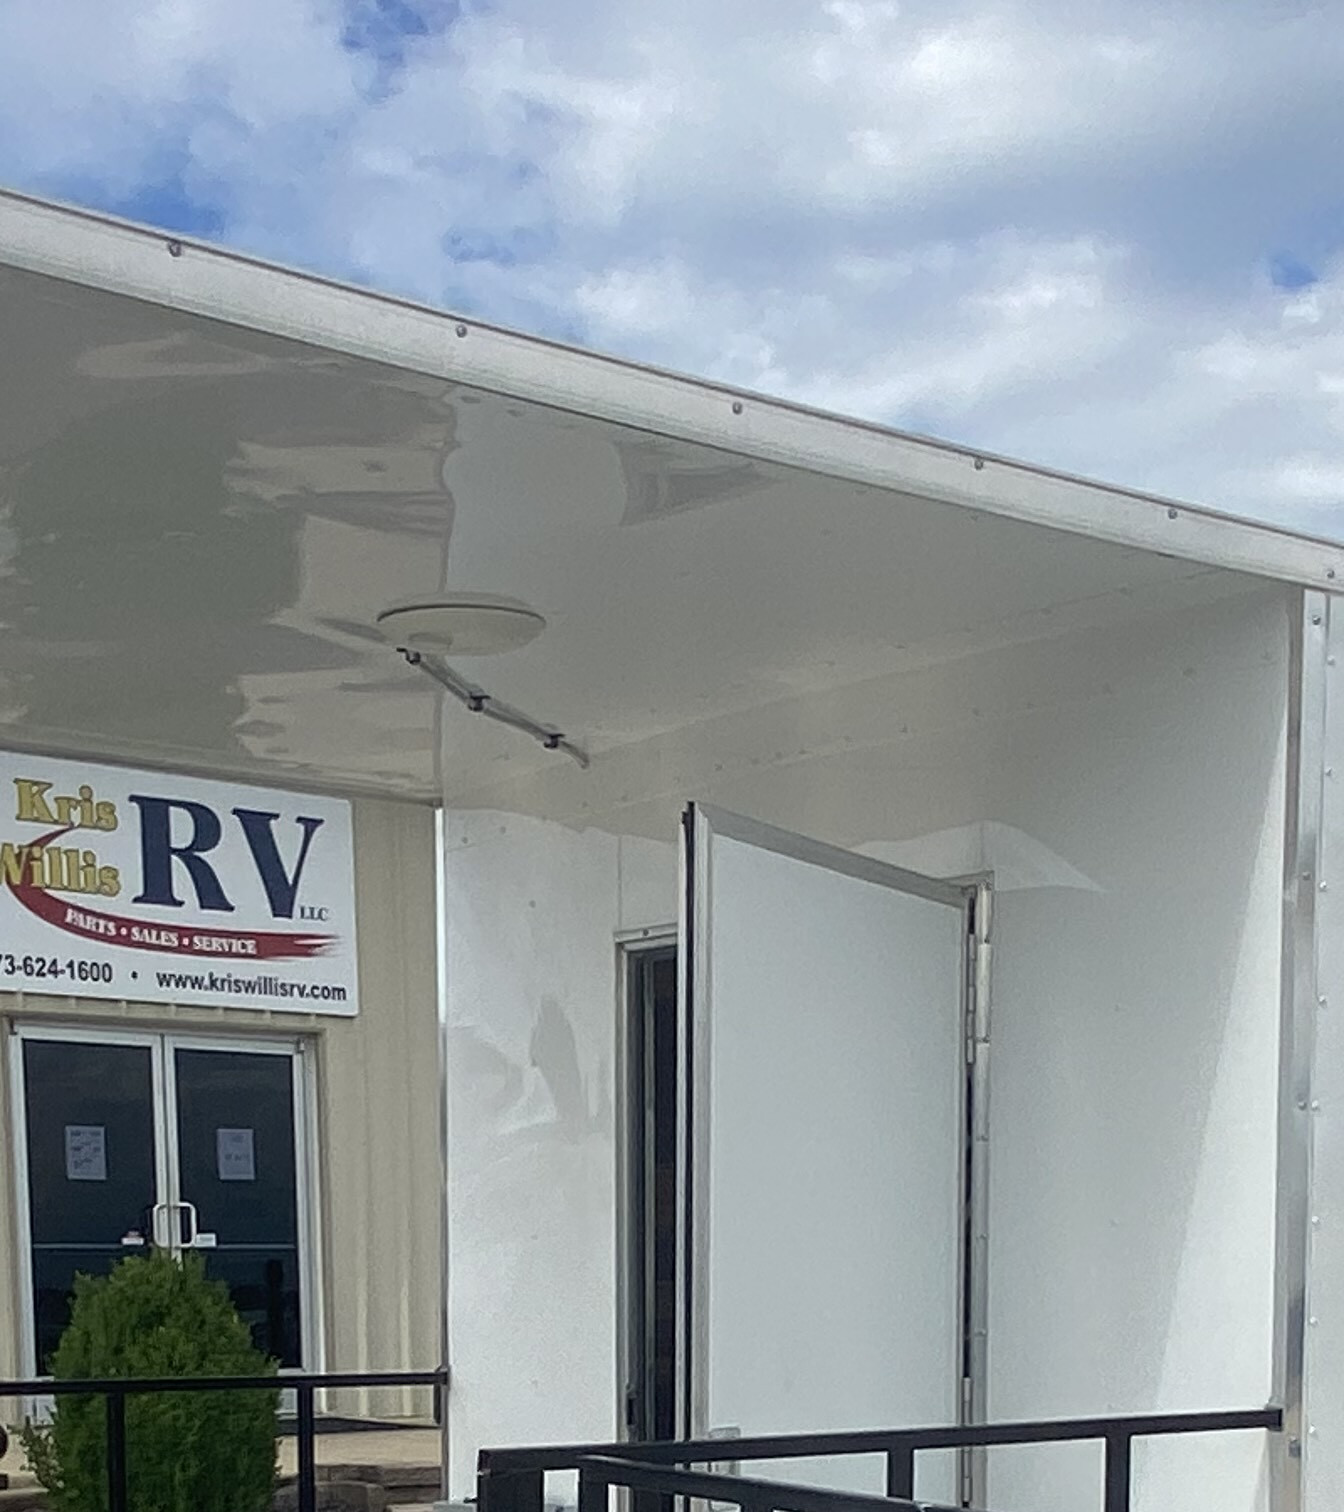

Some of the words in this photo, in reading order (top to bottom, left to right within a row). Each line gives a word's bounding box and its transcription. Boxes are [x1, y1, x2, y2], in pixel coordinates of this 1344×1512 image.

[14, 778, 118, 832] Kris
[128, 794, 325, 919] RV
[65, 908, 117, 936] PARTS
[131, 928, 179, 946] SALES
[192, 936, 257, 954] SERVICE
[299, 905, 329, 921] LLC
[156, 971, 347, 1001] www.kriswillisrv.com
